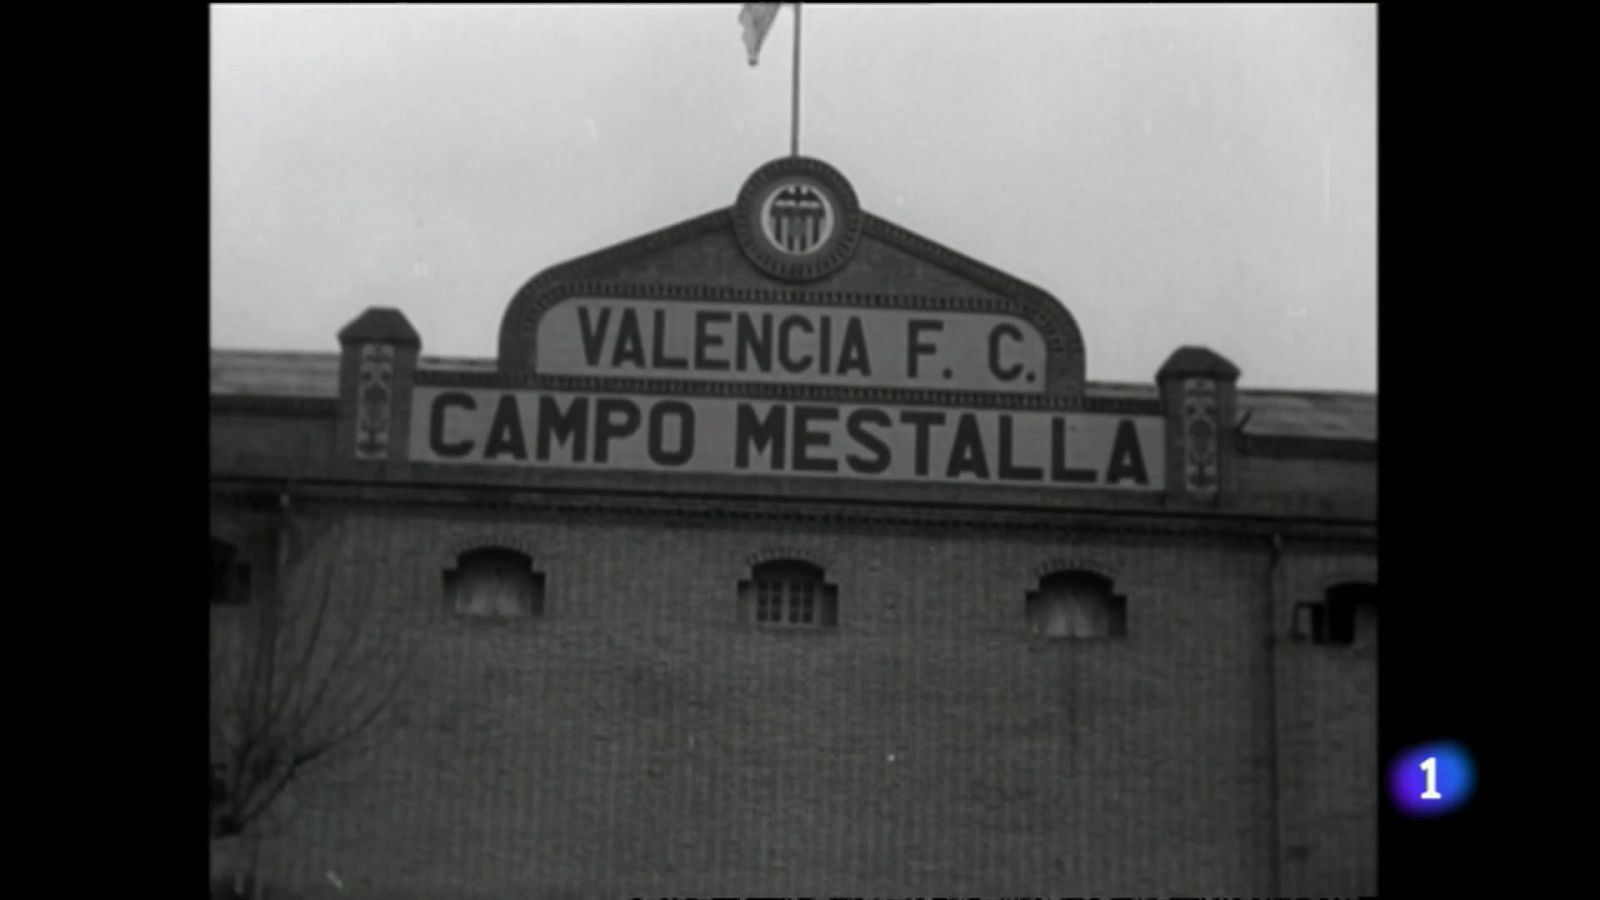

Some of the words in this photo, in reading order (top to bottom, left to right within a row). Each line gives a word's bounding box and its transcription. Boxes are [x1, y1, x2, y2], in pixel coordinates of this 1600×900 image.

[577, 305, 871, 377] VALENCIA
[907, 319, 953, 379] F.
[988, 323, 1036, 383] C.
[429, 392, 695, 466] CAMPO
[735, 403, 1149, 486] MESTALLA
